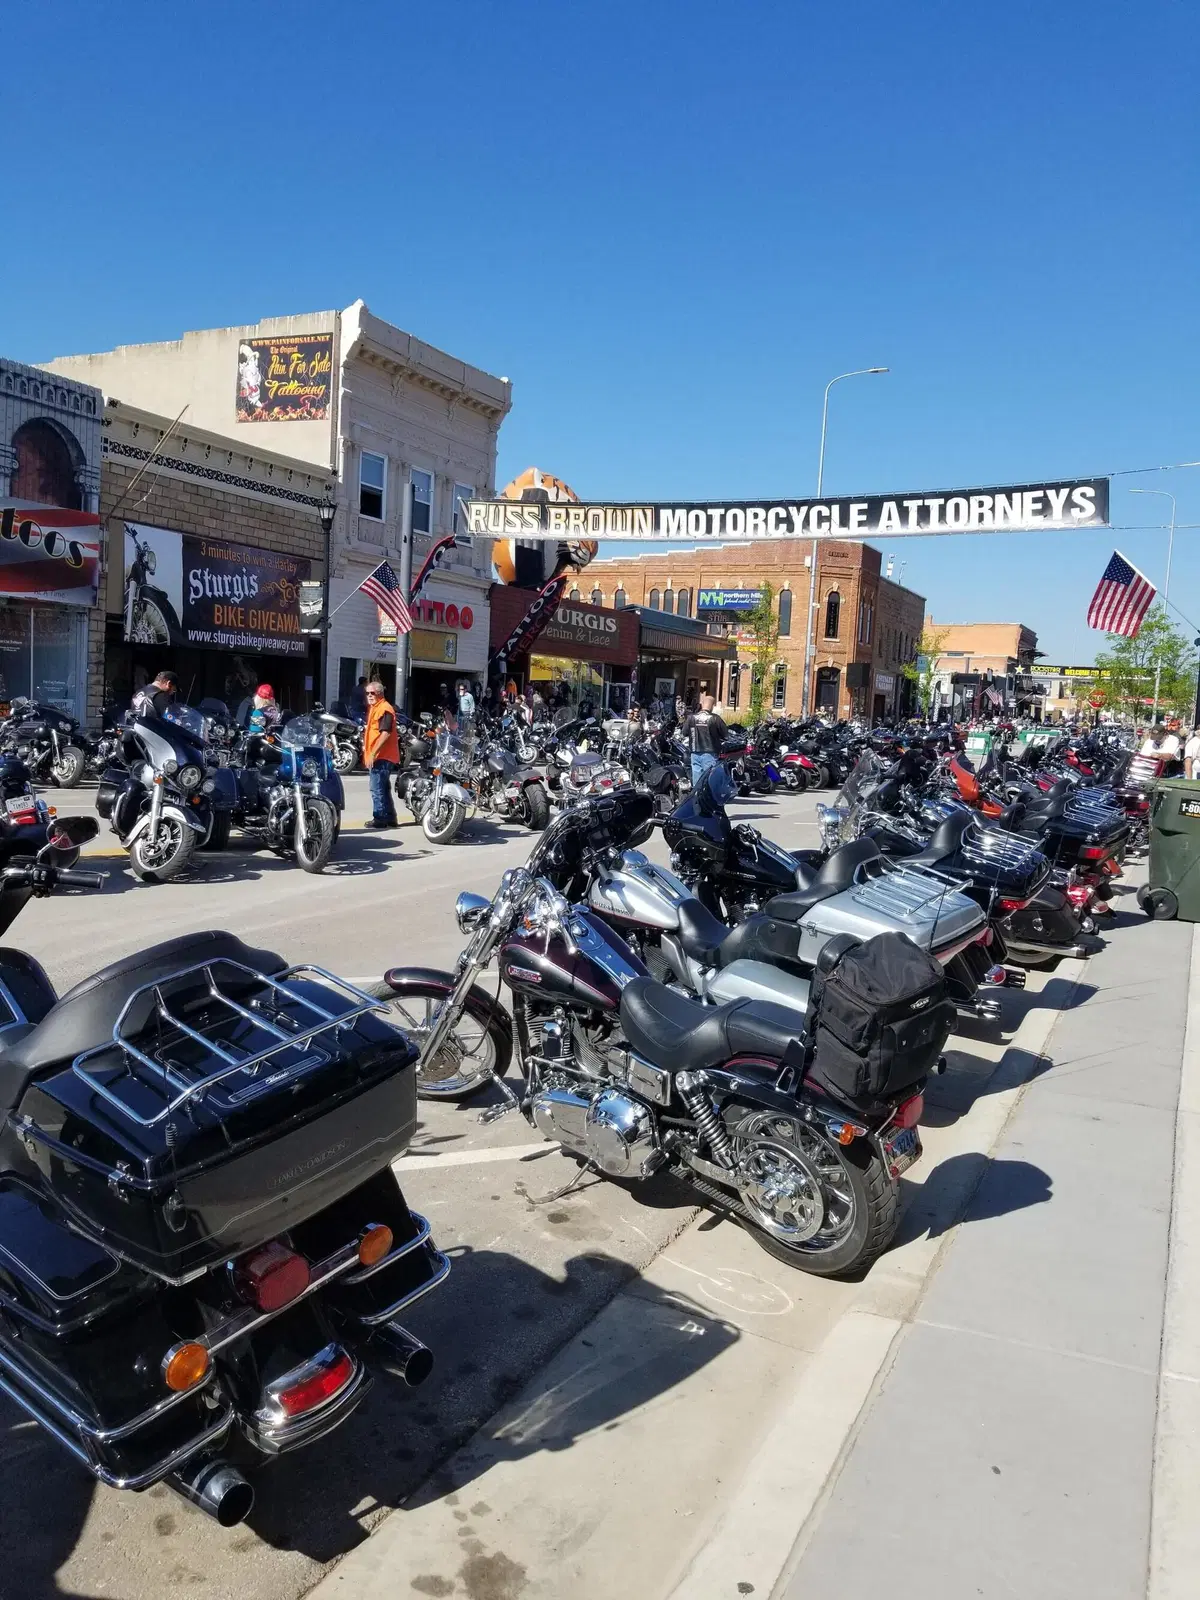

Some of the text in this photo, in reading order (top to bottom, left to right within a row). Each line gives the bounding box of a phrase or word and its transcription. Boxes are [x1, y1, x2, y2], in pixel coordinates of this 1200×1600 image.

[252, 335, 330, 346] WWW.PAINFORSALE.NET
[268, 350, 331, 379] Pain For Sale
[265, 380, 326, 399] Tattooing
[468, 486, 1096, 538] RUSS BROWN MOTORCYCLE ATTORNEYS
[0, 507, 85, 568] toos
[201, 542, 206, 555] 3
[208, 544, 241, 561] minutes
[243, 552, 250, 564] to
[252, 556, 267, 567] win
[274, 558, 298, 575] Harley
[189, 567, 259, 605] Sturgis
[214, 604, 300, 634] BIKE GIVEAWA
[409, 599, 473, 630] ATTOO
[496, 581, 558, 659] TATTOO
[550, 608, 617, 632] URGIS
[188, 629, 305, 653] www.sturgisbikegiveaway.com
[576, 628, 587, 641] &
[588, 631, 610, 646] Lace
